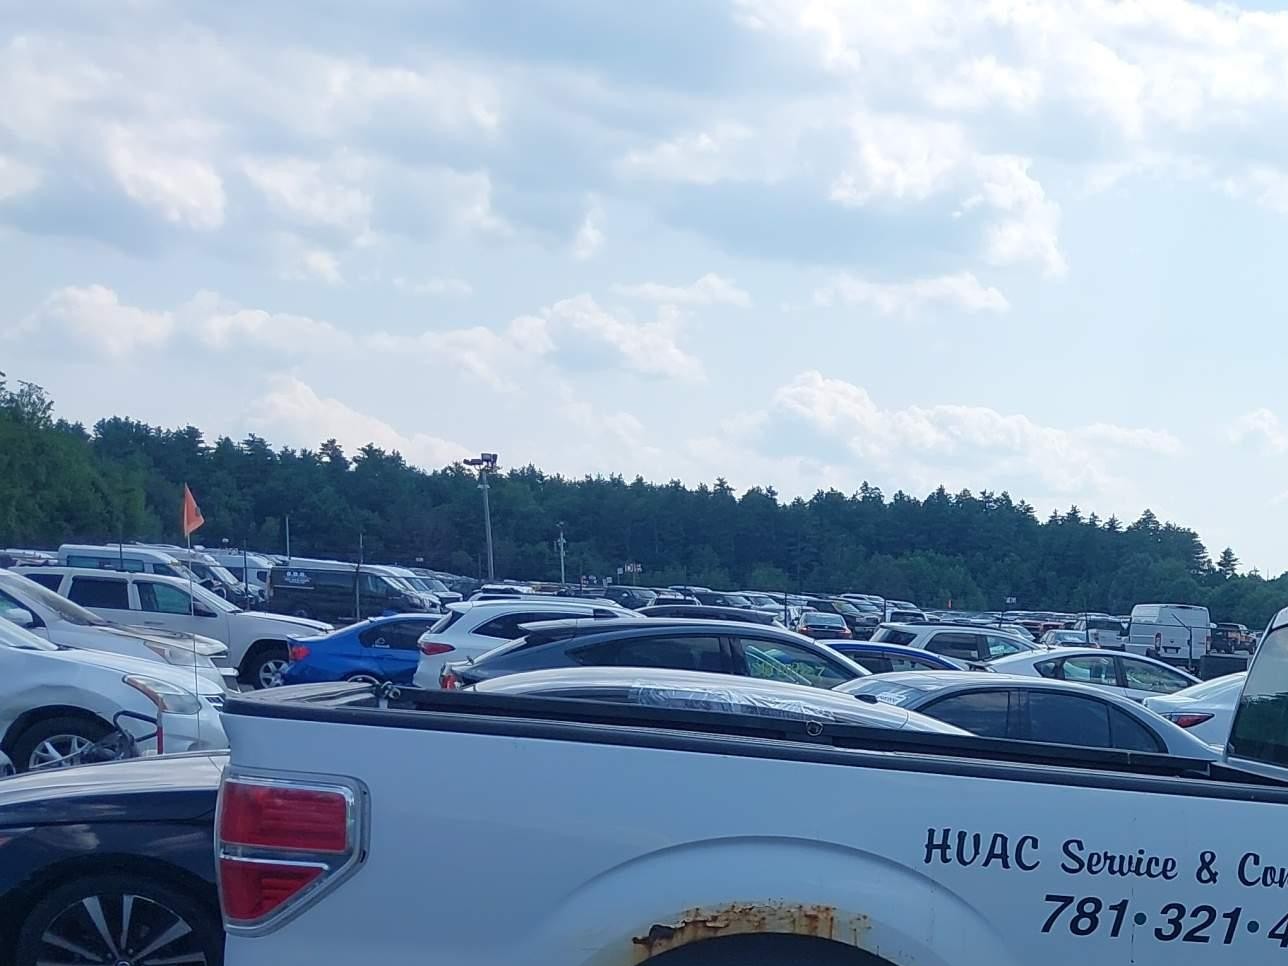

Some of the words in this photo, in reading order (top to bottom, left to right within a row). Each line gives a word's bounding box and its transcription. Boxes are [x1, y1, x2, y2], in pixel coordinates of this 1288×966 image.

[924, 827, 1040, 871] HVAC
[1061, 839, 1178, 881] Service
[1196, 850, 1219, 884] &
